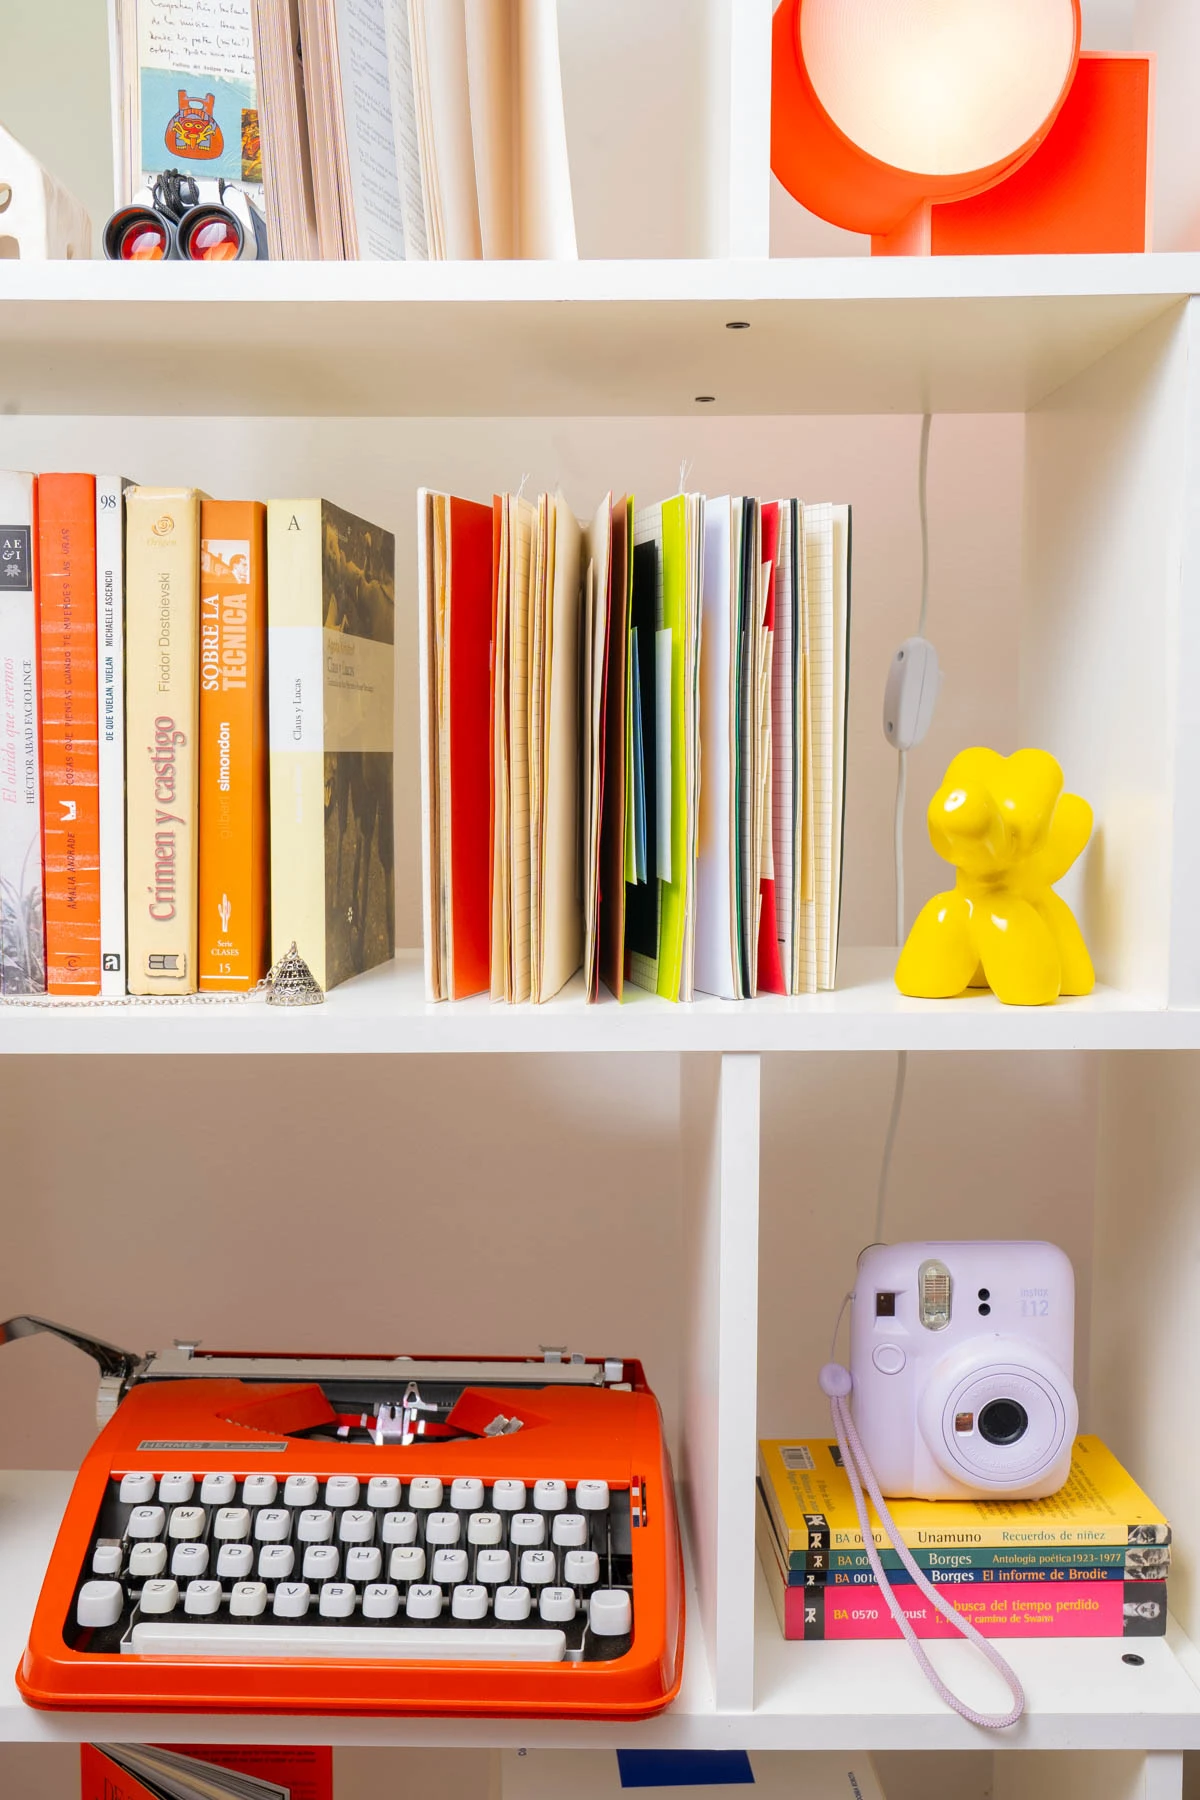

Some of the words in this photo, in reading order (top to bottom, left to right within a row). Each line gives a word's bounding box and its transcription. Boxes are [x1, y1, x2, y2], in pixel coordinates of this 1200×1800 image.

[100, 494, 116, 510] 98
[288, 514, 302, 531] A
[63, 561, 71, 577] LAS
[105, 570, 113, 606] ASCENCIO
[62, 582, 72, 630] MUERDES
[158, 572, 171, 647] Dostoievski
[202, 594, 219, 620] LA
[64, 634, 71, 646] TE
[105, 608, 114, 647] MICHAELLE
[219, 593, 248, 692] TÉCNICA
[106, 656, 114, 686] VUELAN
[202, 624, 219, 692] SOBRE
[4, 657, 15, 708] seremos
[158, 651, 171, 693] Fiodor
[23, 660, 33, 725] FACIOLINCE
[106, 686, 114, 718] VUELAN,
[292, 678, 302, 706] Lucas
[65, 690, 74, 727] PIENSAS
[294, 706, 304, 714] y
[6, 712, 20, 738] que
[106, 716, 114, 732] QUE
[106, 732, 114, 741] DE
[292, 714, 302, 742] Claus
[25, 727, 34, 758] ABAD
[65, 732, 74, 750] QUE
[1, 742, 17, 784] olvido
[148, 715, 187, 804] castigo
[217, 722, 230, 792] simondon
[24, 759, 34, 804] HÉCTOR
[65, 756, 74, 786] COSAS
[2, 788, 16, 804] El
[154, 808, 187, 825] y
[67, 832, 76, 872] ANDRADE
[148, 832, 177, 922] Crimen
[68, 876, 77, 910] AMALIA
[210, 948, 240, 956] CLASES
[217, 940, 233, 948] Serie
[219, 963, 231, 974] 15
[1020, 1288, 1049, 1298] instax
[1030, 1300, 1048, 1317] 12
[139, 1510, 153, 1518] Q
[180, 1510, 194, 1518] W
[835, 1534, 850, 1544] BA
[854, 1534, 882, 1544] 00
[918, 1531, 982, 1544] Unamuno
[1002, 1530, 1056, 1541] Recuerdos
[1060, 1530, 1072, 1540] de
[1077, 1530, 1106, 1540] niñez
[270, 1549, 286, 1558] F
[532, 1552, 545, 1562] Ñ
[838, 1556, 852, 1566] BA
[928, 1553, 972, 1567] Borges
[992, 1554, 1037, 1566] Antología
[1072, 1553, 1122, 1563] 1923-1977
[834, 1574, 850, 1584] BA
[932, 1570, 974, 1584] Borges
[982, 1570, 994, 1581] El
[999, 1569, 1046, 1580] informe
[1050, 1569, 1064, 1580] de
[1069, 1568, 1109, 1580] Brodie
[240, 1587, 256, 1595] C
[286, 1587, 300, 1596] V
[330, 1588, 344, 1596] B
[374, 1588, 388, 1596] N
[416, 1589, 433, 1597] M
[833, 1609, 849, 1620] BA
[852, 1609, 878, 1620] 0570
[953, 1600, 986, 1612] busca
[990, 1600, 1008, 1611] del
[1012, 1600, 1052, 1613] tiempo
[1056, 1599, 1100, 1613] perdido
[974, 1615, 1008, 1624] camino
[1010, 1615, 1021, 1624] de
[1024, 1614, 1054, 1624] Swann
